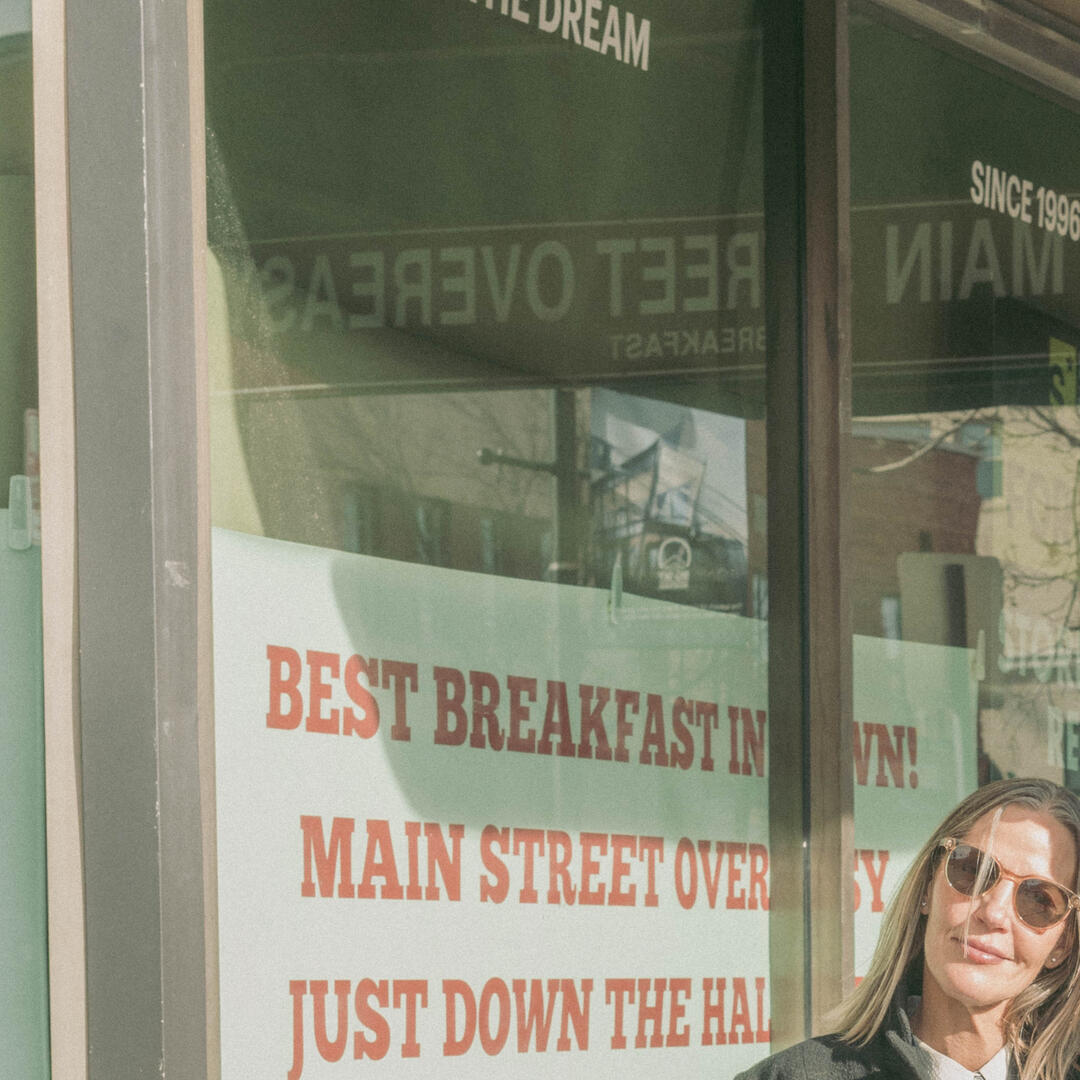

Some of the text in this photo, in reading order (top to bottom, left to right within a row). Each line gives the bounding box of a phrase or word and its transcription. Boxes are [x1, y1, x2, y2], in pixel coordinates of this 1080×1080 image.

[538, 0, 651, 71] DREAM
[970, 160, 1080, 241] SINCE 1996
[266, 645, 419, 743] BEST
[432, 666, 719, 777] BREAKFAST
[728, 706, 767, 777] IN
[300, 815, 462, 901] MAIN
[480, 824, 664, 908] STREET
[442, 978, 594, 1057] DOWN
[605, 977, 692, 1050] THE
[701, 976, 771, 1046] HAL
